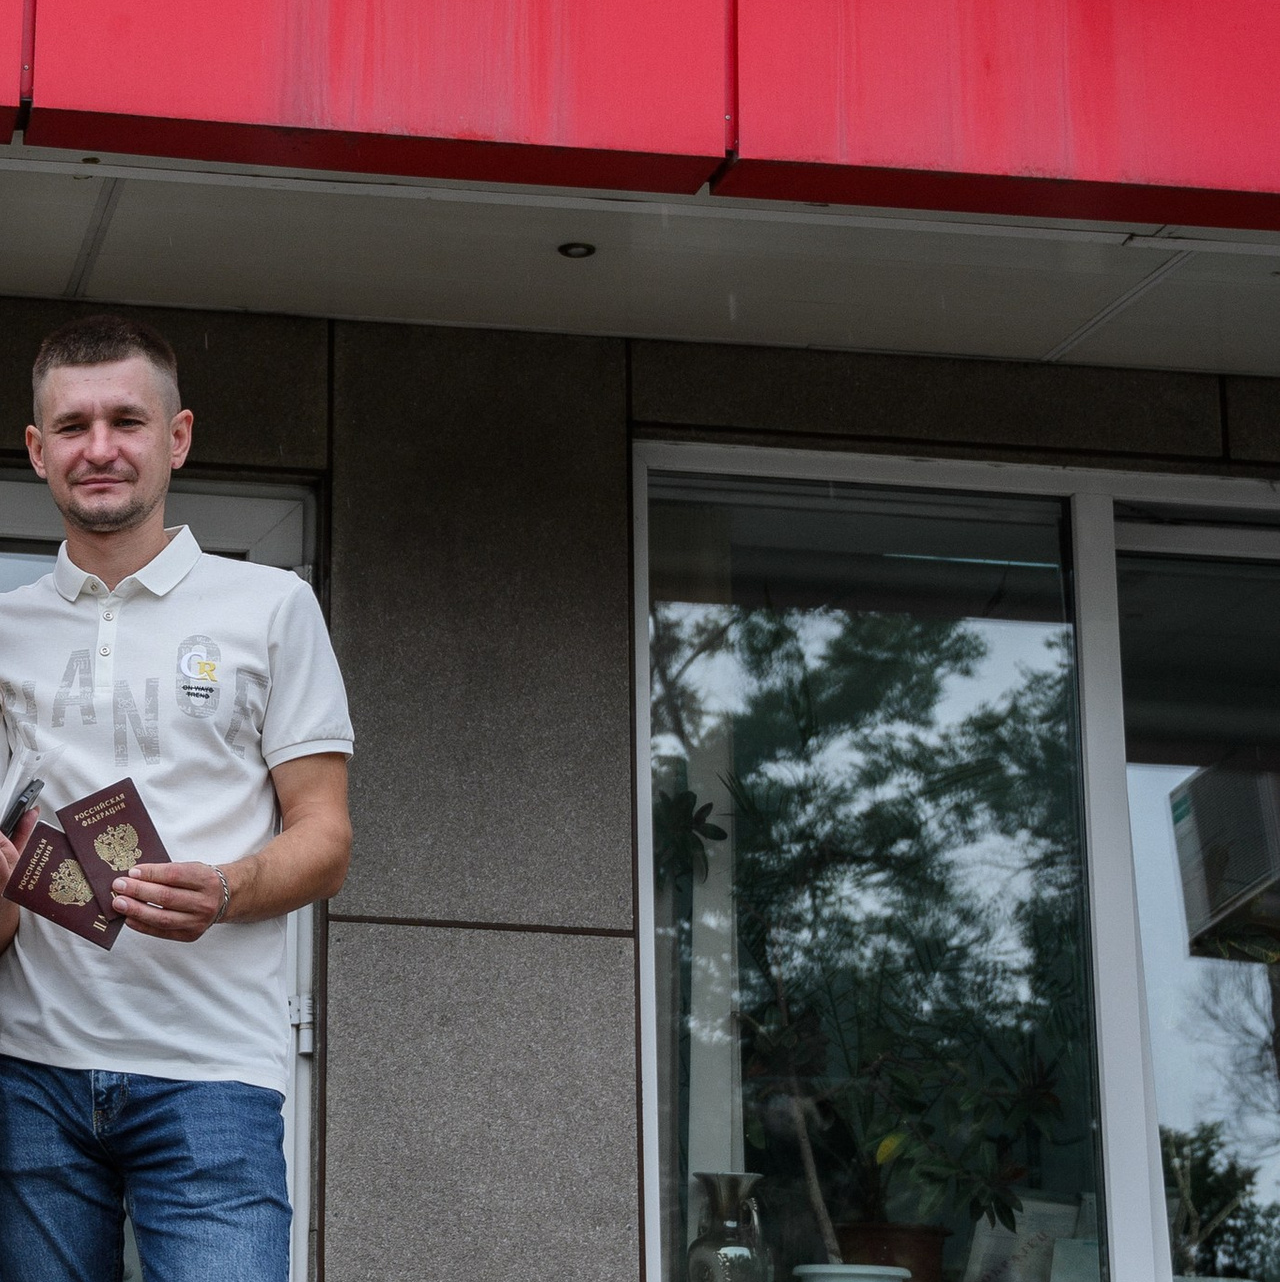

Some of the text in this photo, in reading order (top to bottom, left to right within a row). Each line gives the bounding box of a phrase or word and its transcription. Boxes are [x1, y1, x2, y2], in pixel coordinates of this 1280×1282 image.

[74, 793, 126, 821] РОССИЙСКАЯ
[81, 802, 126, 828] ФЕДЕРАЦИЯ
[18, 838, 47, 890] РОССИЙСКАЯ
[28, 844, 54, 891] ФЕДЕРАЦИЯ
